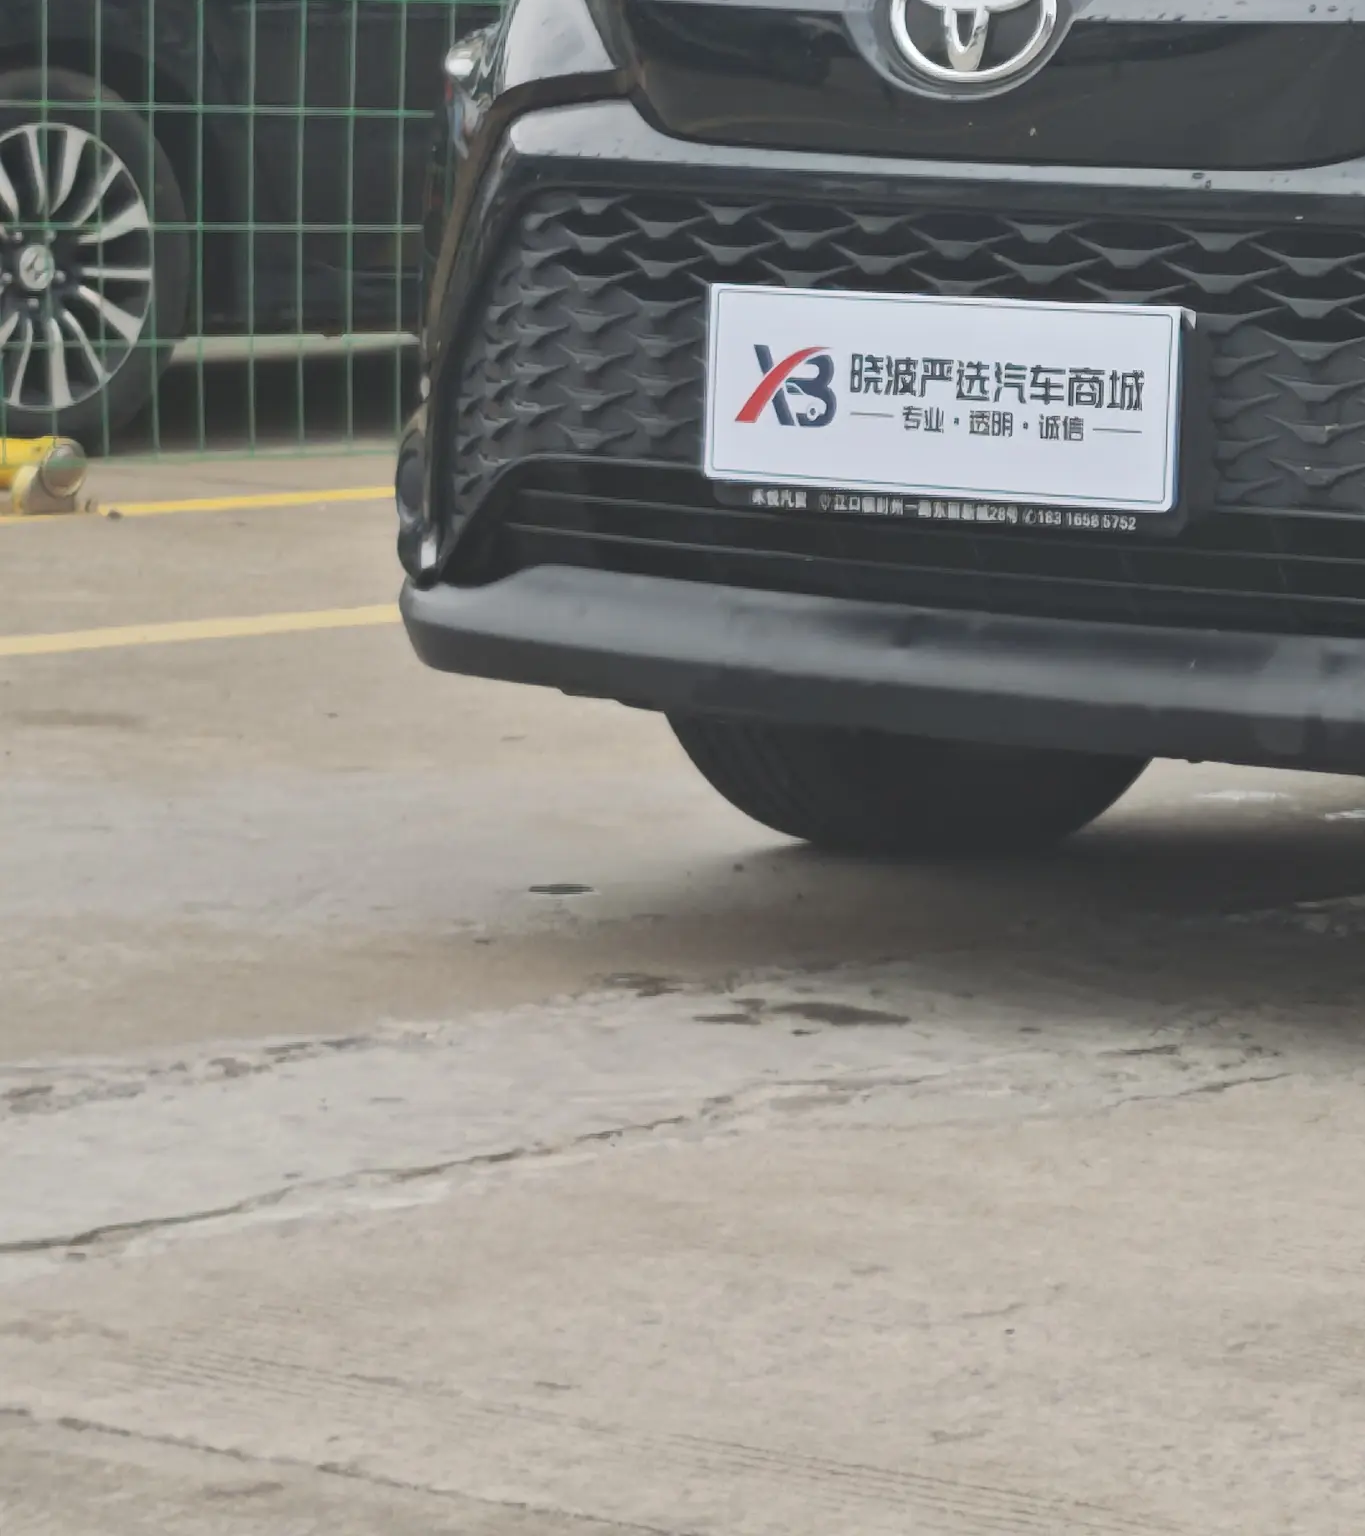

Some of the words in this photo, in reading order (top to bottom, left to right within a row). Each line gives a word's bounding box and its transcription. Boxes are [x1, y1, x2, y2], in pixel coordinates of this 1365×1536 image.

[849, 353, 1146, 412] 晓波严选汽车商城
